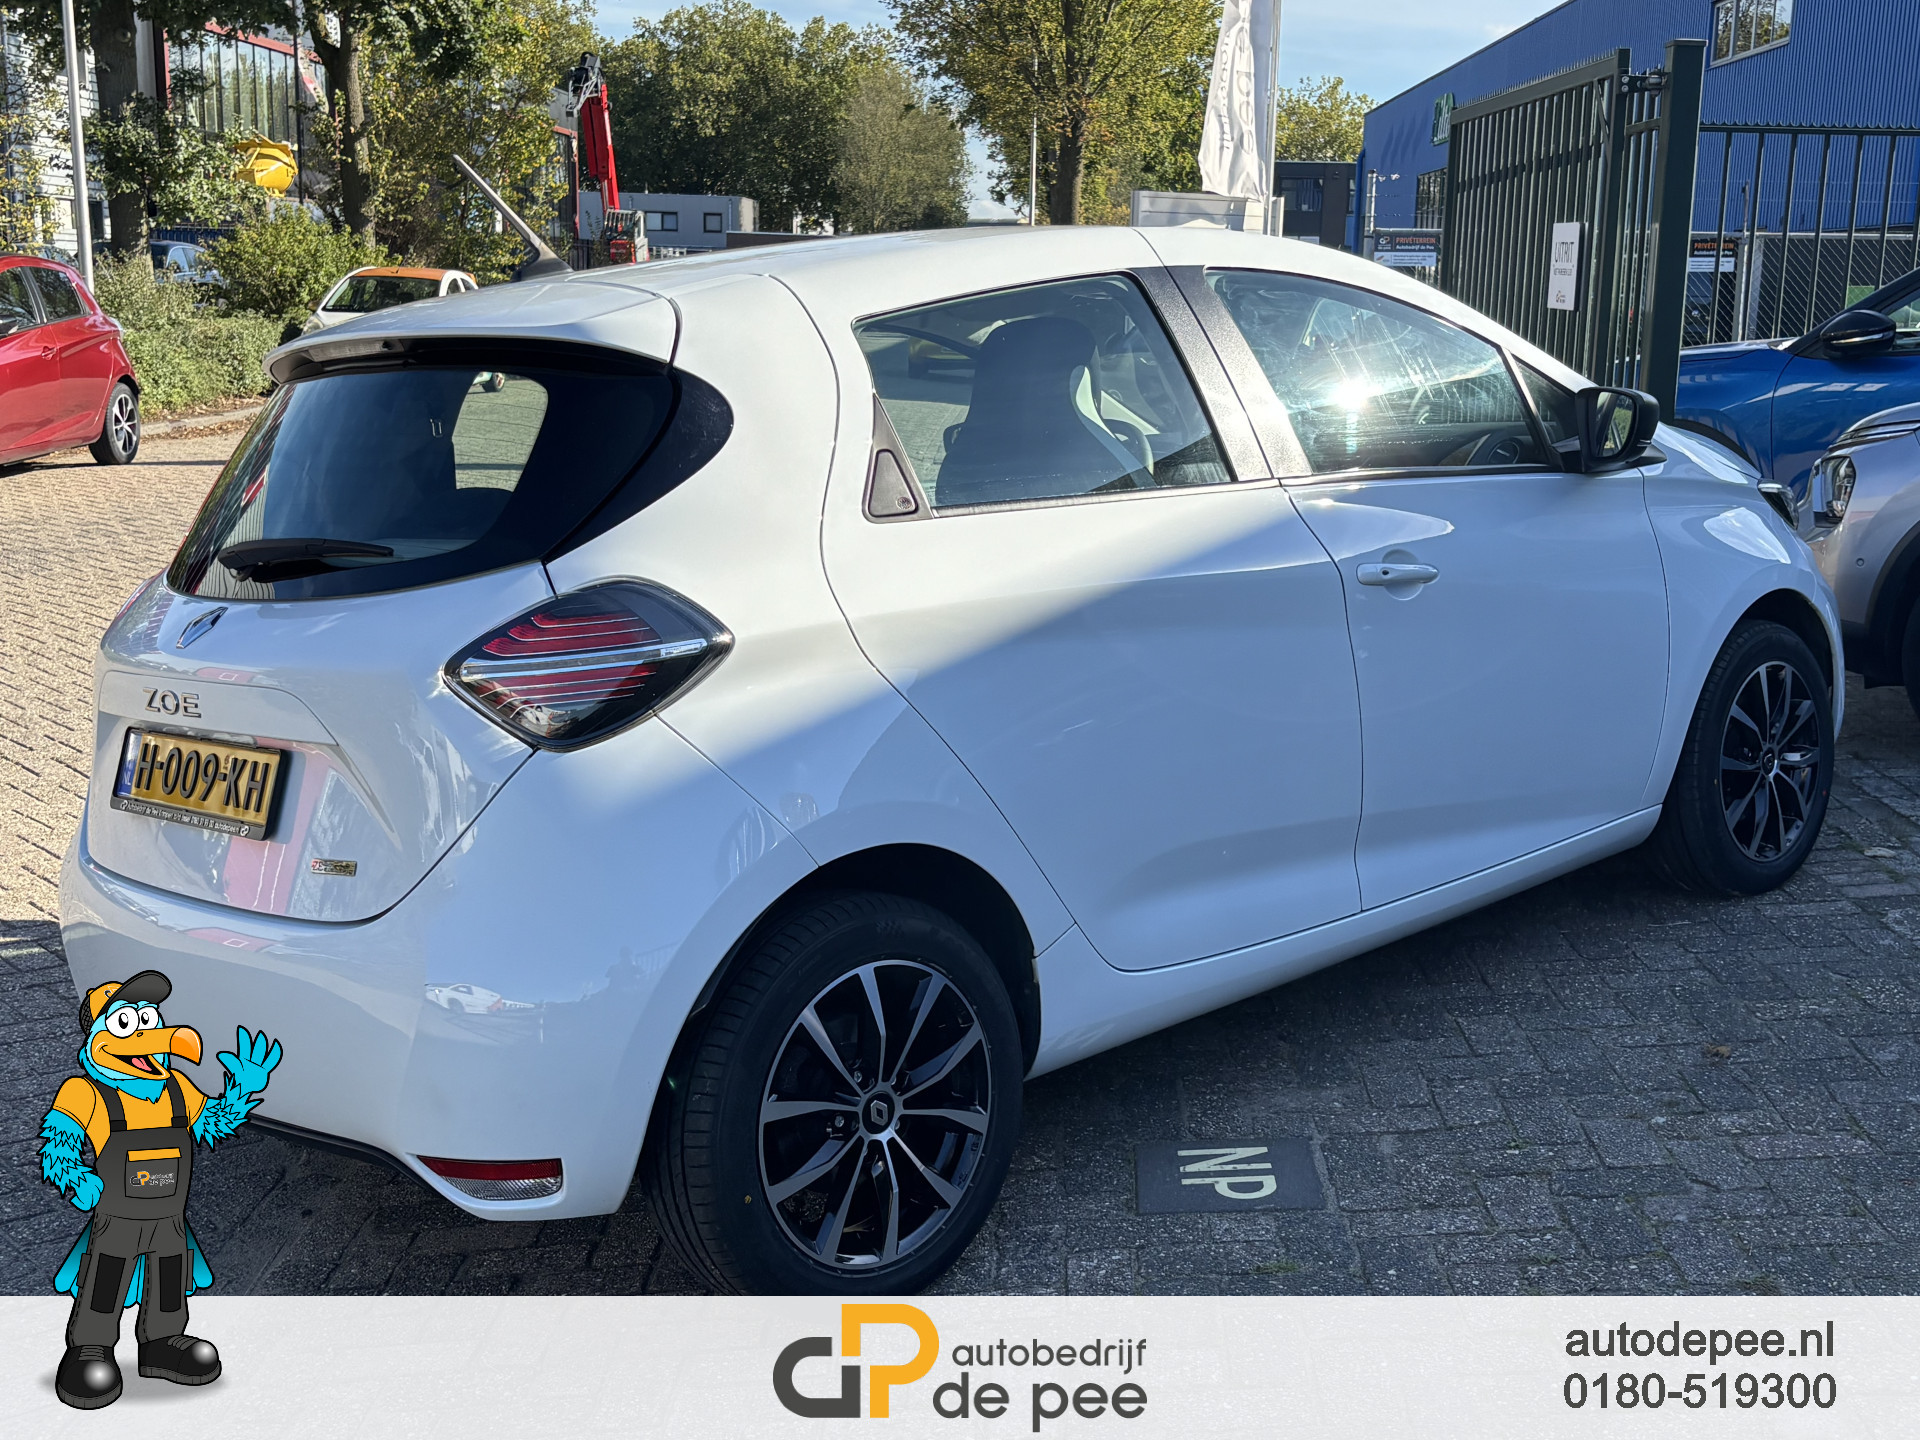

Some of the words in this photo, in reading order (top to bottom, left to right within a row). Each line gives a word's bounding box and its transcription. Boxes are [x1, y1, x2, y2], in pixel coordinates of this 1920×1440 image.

[143, 687, 202, 718] ZOE
[134, 743, 271, 813] H-009-KH
[1177, 1146, 1278, 1200] NP
